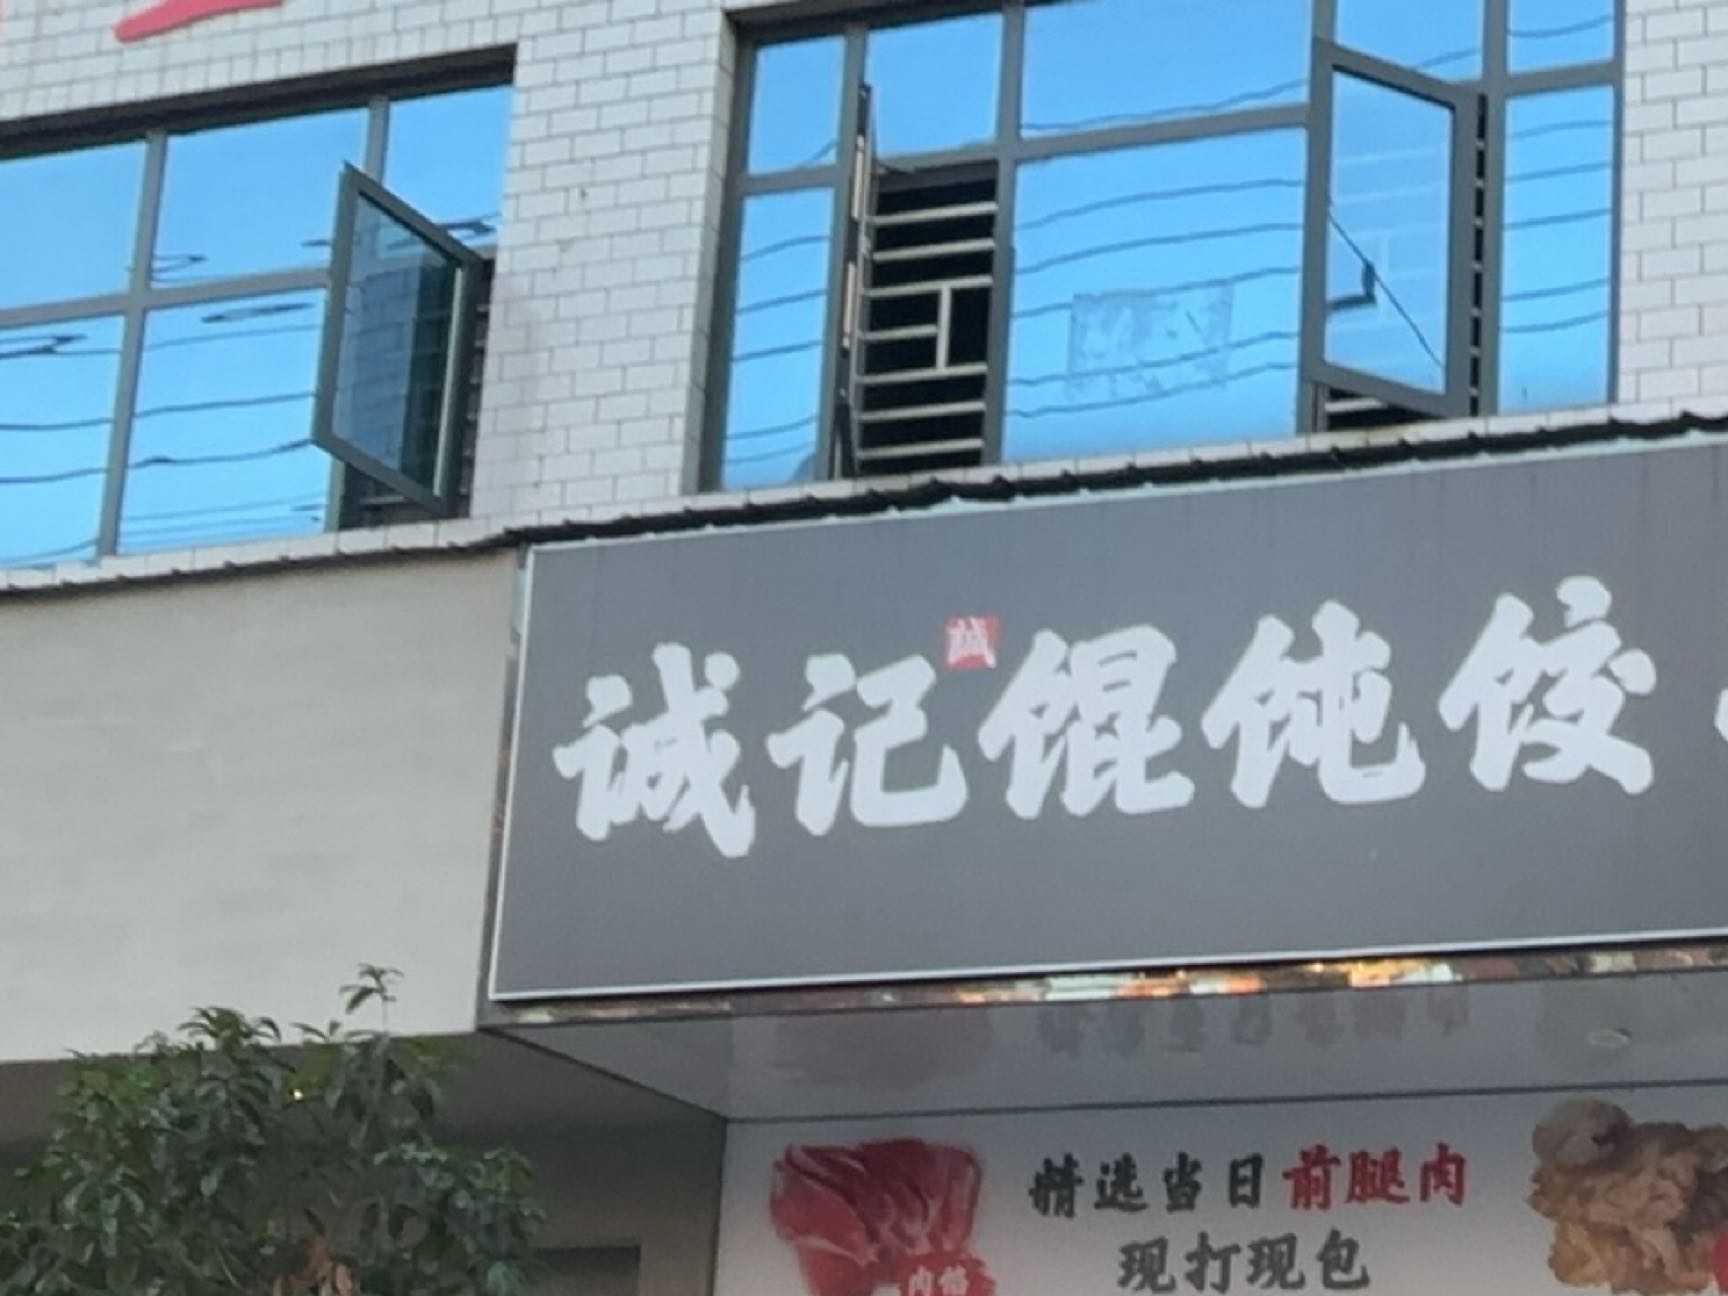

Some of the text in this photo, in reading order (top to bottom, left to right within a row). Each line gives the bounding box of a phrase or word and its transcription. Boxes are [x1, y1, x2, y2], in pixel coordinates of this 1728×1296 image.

[1028, 1141, 1468, 1219] 精选当日前腿肉
[1117, 1228, 1371, 1295] 现打现包
